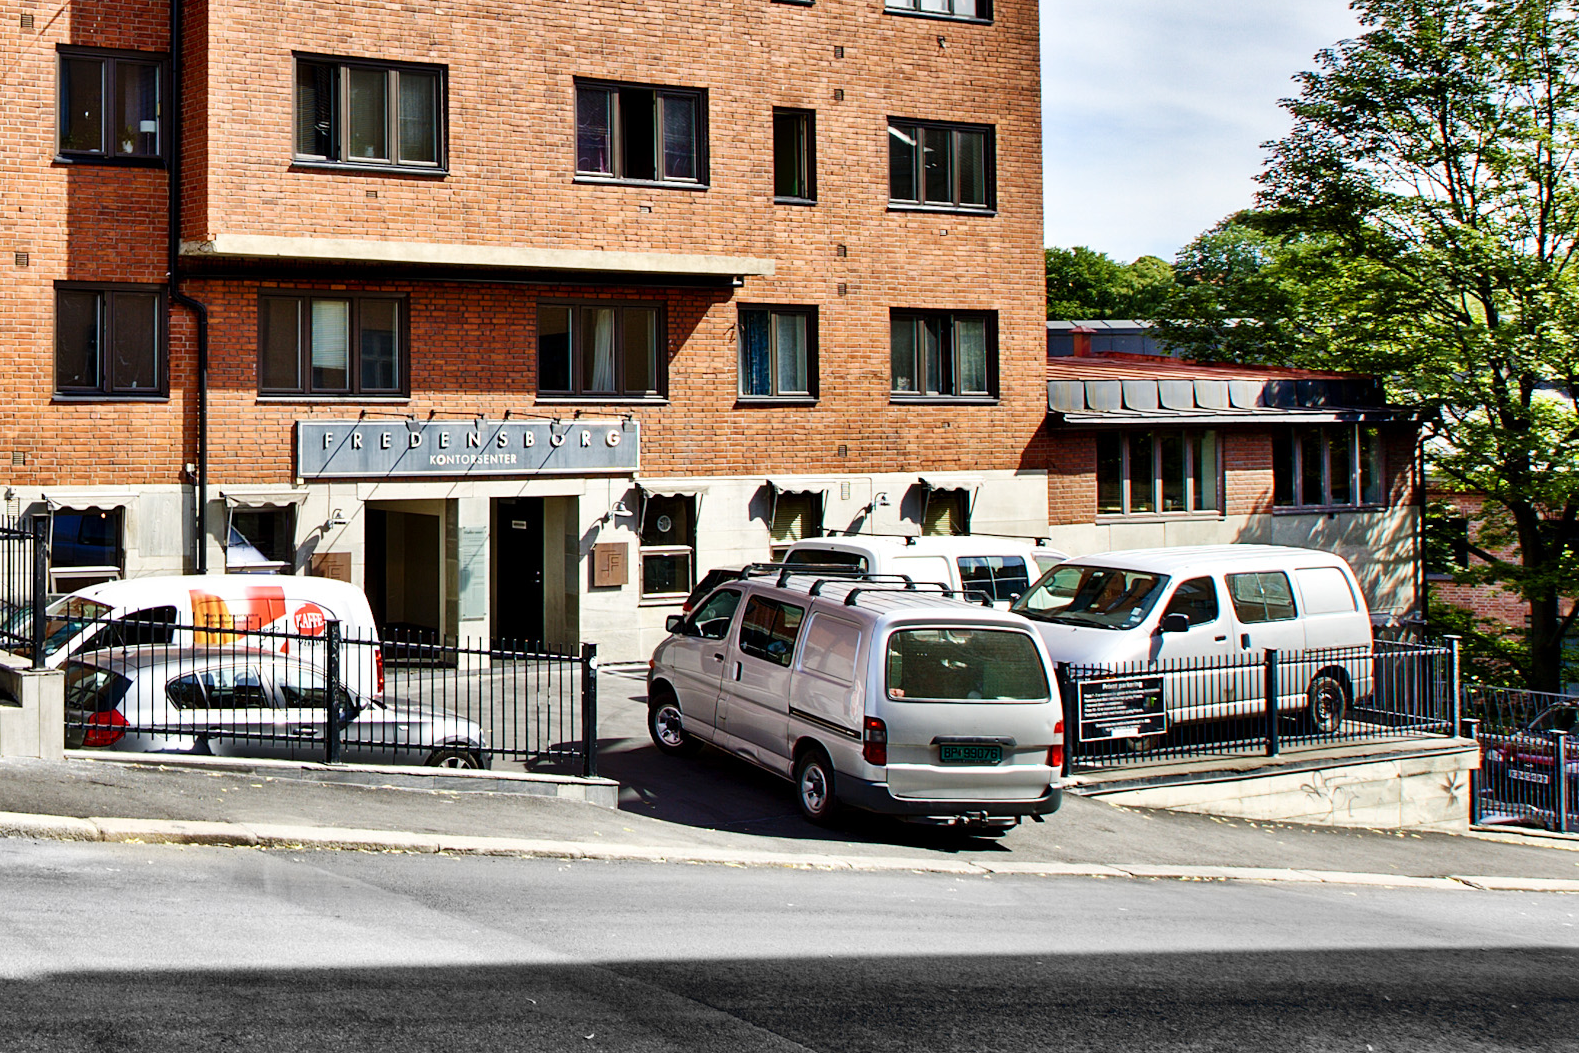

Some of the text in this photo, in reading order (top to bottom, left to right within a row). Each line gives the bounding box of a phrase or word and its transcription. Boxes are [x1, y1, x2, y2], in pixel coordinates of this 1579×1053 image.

[322, 430, 622, 449] FREDENSBORG
[429, 453, 517, 466] KONTORSENTER
[295, 613, 324, 628] KAFFE
[944, 747, 998, 759] BP 99076
